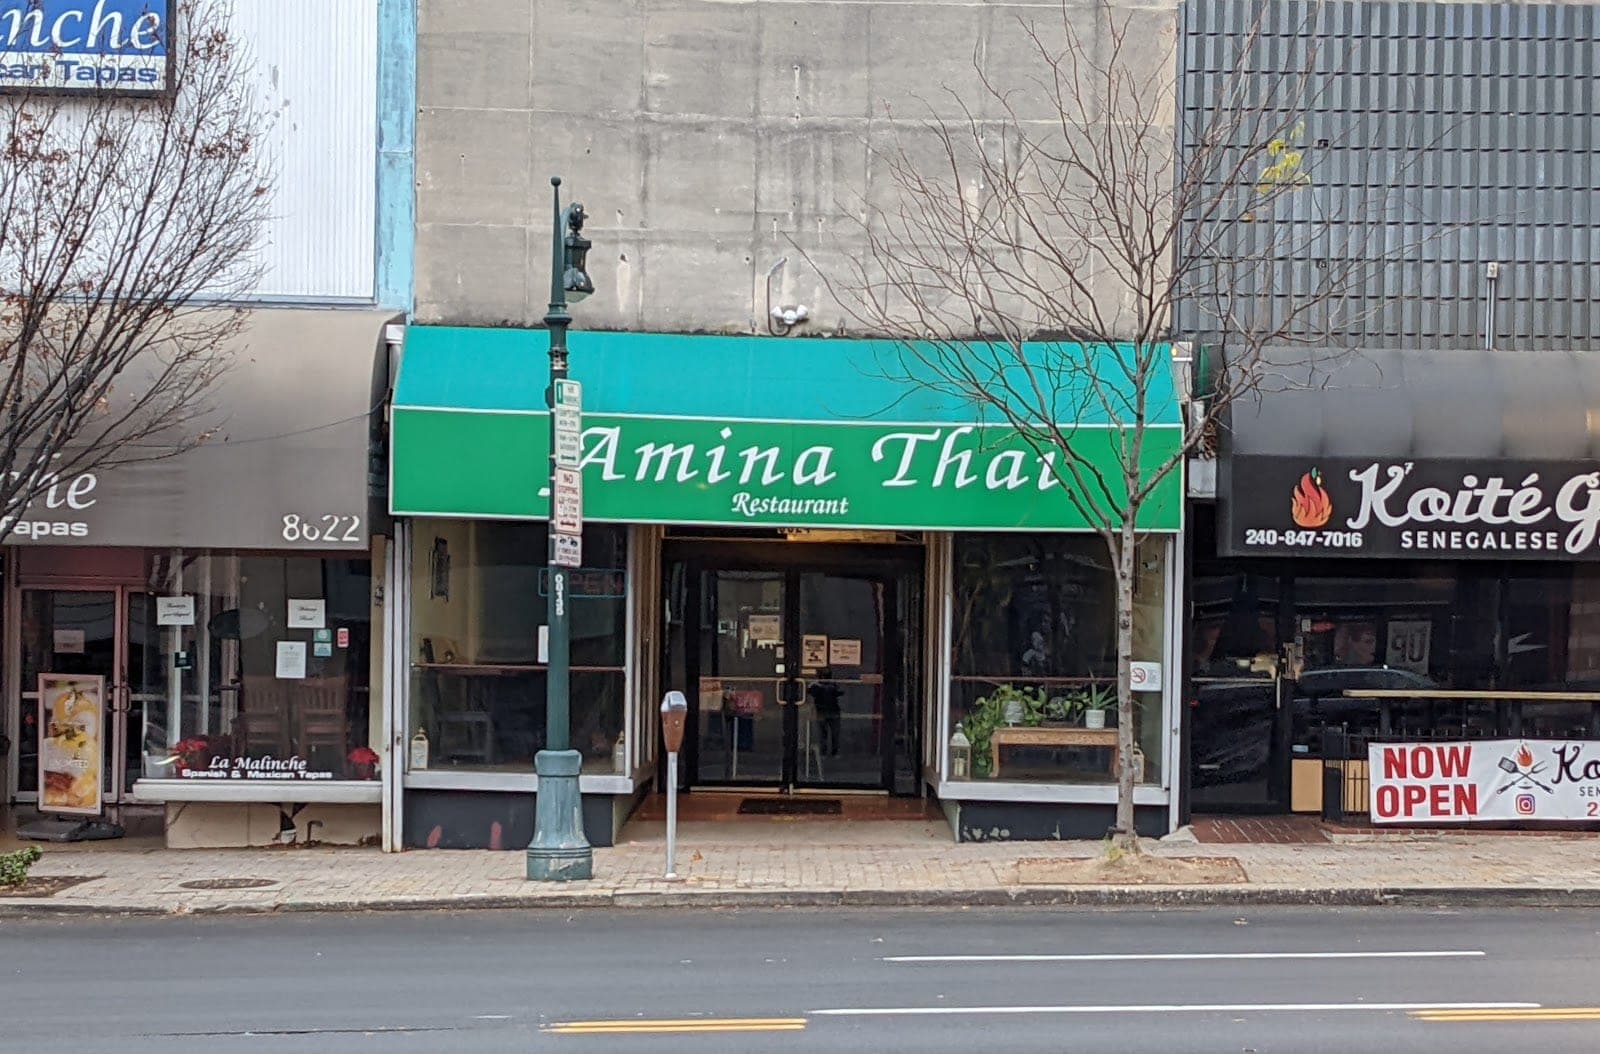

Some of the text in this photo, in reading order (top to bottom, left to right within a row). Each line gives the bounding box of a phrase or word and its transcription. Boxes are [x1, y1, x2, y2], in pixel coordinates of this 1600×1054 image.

[0, 0, 160, 49] nche
[56, 60, 157, 82] Tapas
[575, 425, 1059, 491] Amina Thai
[731, 491, 848, 517] Restaurant
[1245, 529, 1363, 548] 240-847-7016
[1401, 531, 1558, 550] SENEGALESE
[182, 769, 333, 779] Spanish & Mexican Tapas
[208, 755, 307, 770] La Malinche
[1383, 746, 1472, 779] NOW
[1376, 783, 1480, 818] OPEN
